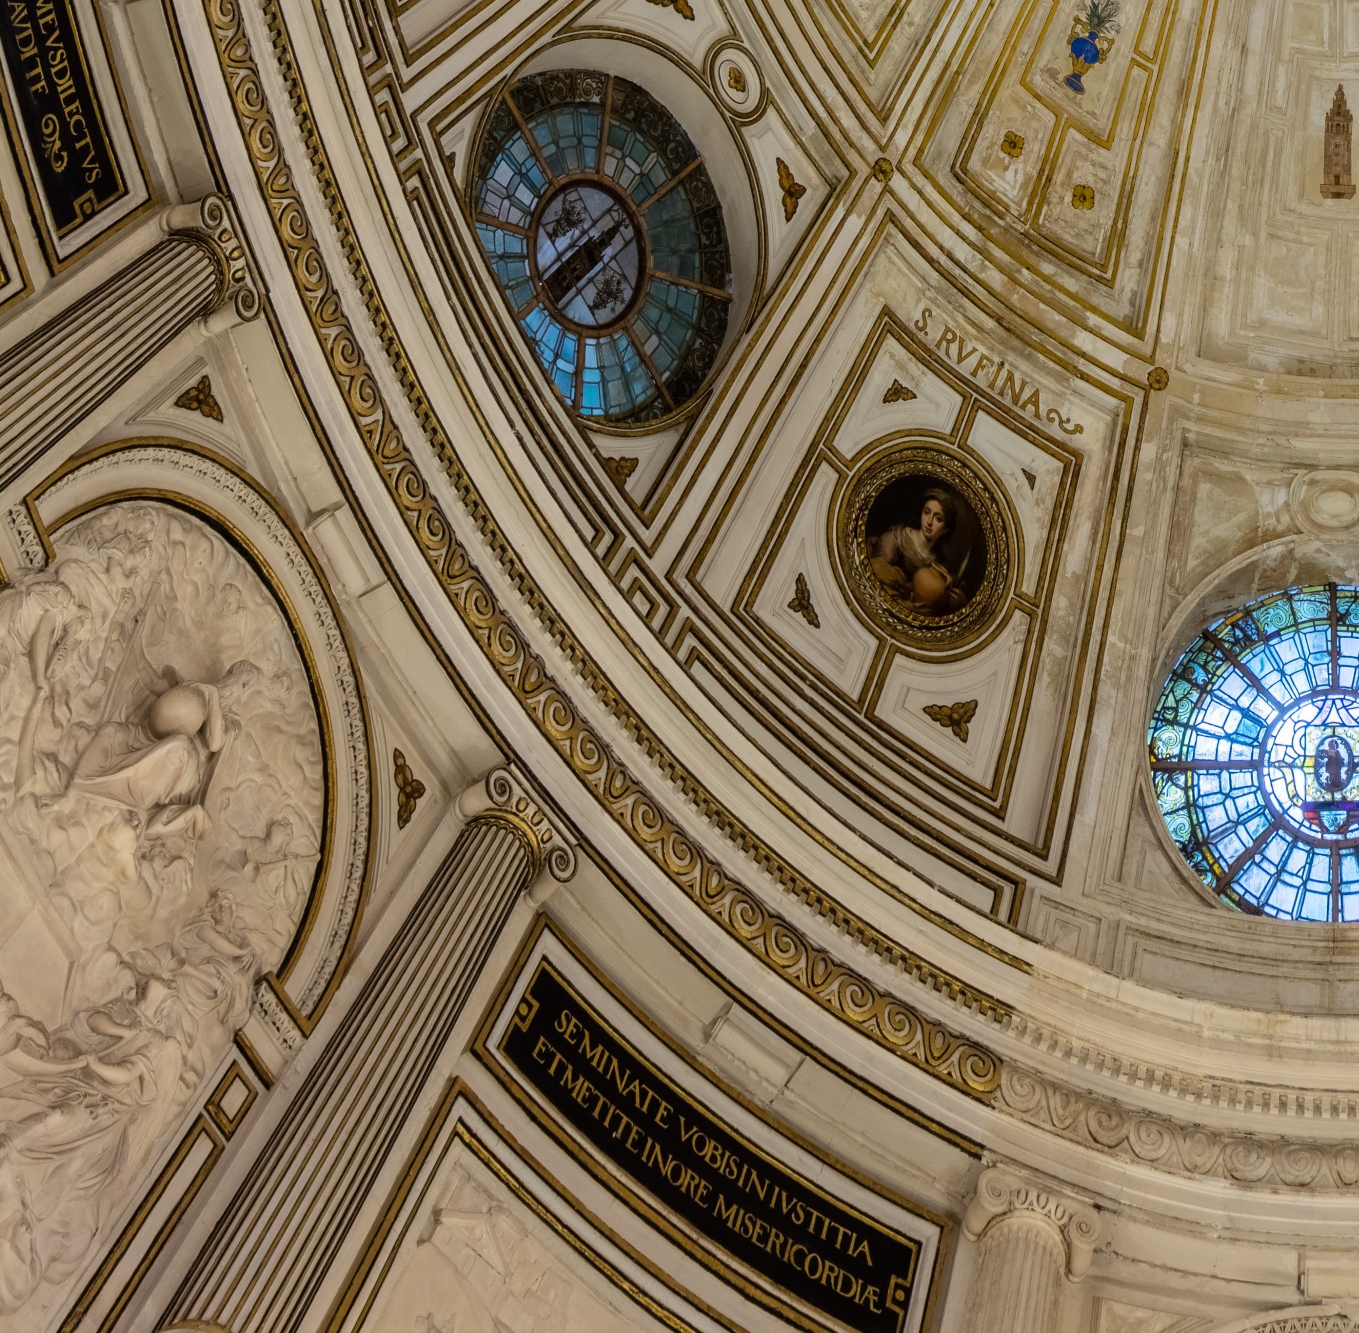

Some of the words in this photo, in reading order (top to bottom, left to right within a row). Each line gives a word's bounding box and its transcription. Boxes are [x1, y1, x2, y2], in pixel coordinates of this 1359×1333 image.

[50, 60, 101, 183] DILECTVS
[914, 308, 933, 337] S.
[934, 323, 1042, 421] RVFINA
[554, 1010, 673, 1129] SEMINATE
[679, 1115, 746, 1179] VOBIS
[737, 1165, 777, 1200] IN
[769, 1187, 872, 1266] IVSTITIA
